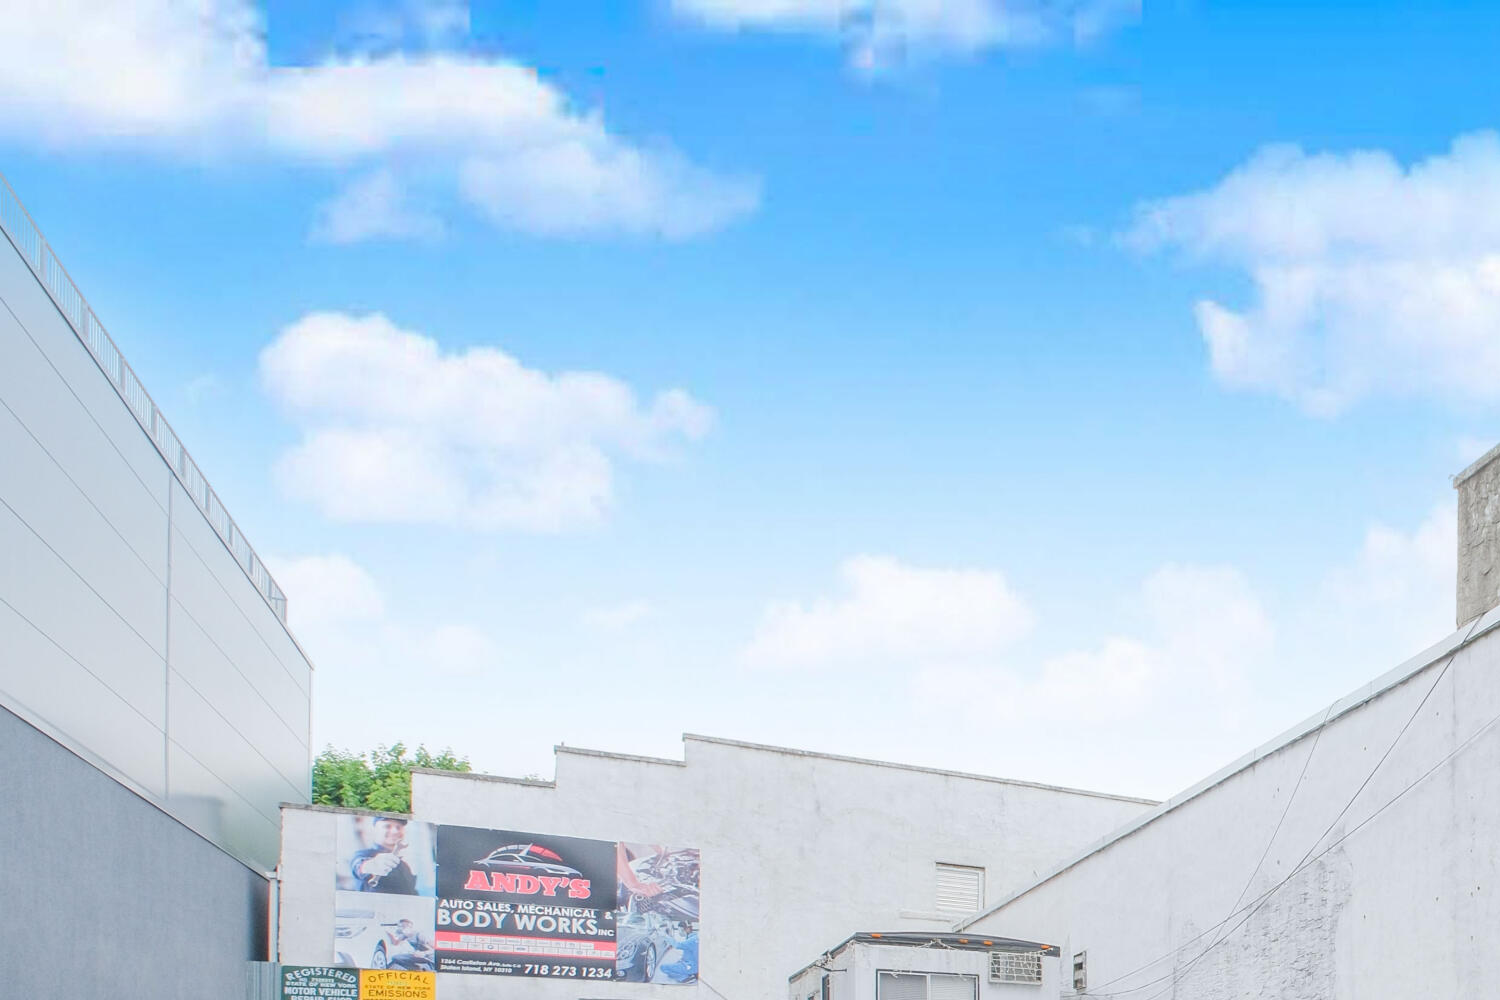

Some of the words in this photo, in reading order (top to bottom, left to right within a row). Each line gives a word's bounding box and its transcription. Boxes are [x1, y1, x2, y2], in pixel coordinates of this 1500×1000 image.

[464, 870, 592, 900] ANDY'S
[440, 900, 474, 910] AUTO
[476, 902, 514, 914] SALES,
[518, 904, 596, 918] MECHANICAL
[604, 911, 613, 920] &
[437, 908, 507, 929] BODY
[514, 914, 598, 936] WORKS
[598, 929, 615, 937] INC
[285, 967, 356, 984] REGISTERED
[368, 972, 429, 984] OFFICIAL
[524, 964, 549, 976] 718
[552, 965, 576, 977] 273
[582, 967, 612, 979] 1234
[284, 986, 317, 995] MOTOR
[319, 988, 358, 997] VEHICLE
[368, 990, 428, 998] EMISSIONS
